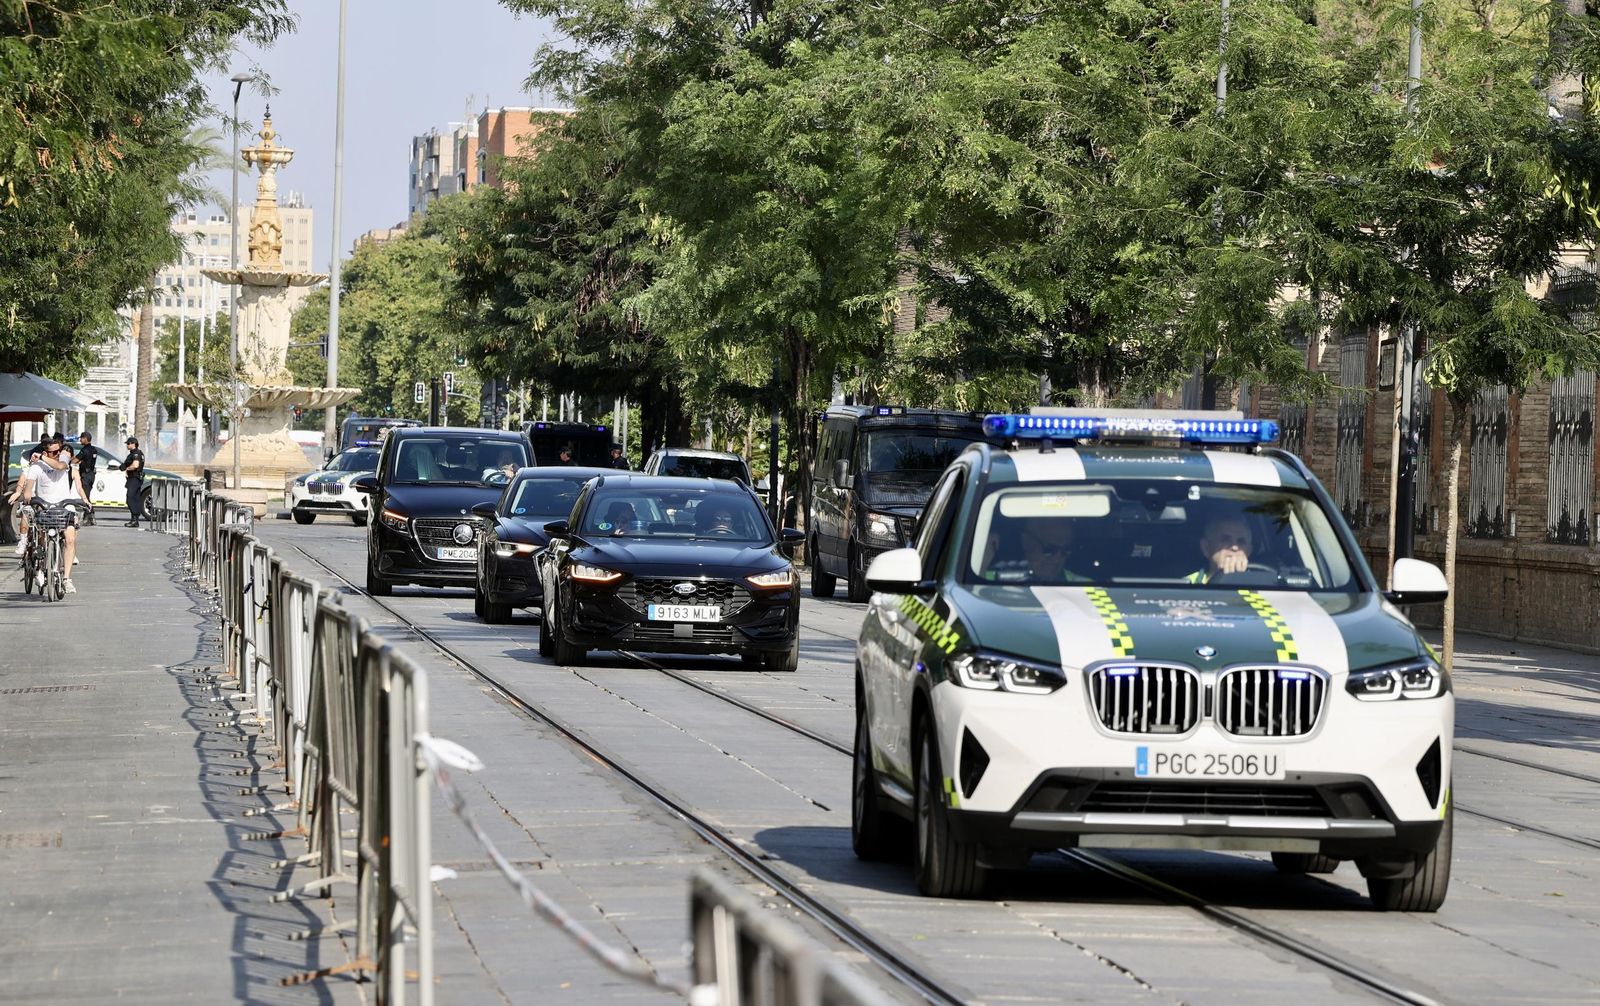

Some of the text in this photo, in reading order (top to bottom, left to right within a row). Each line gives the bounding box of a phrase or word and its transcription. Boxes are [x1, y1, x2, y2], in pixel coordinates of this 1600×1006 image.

[657, 606, 717, 620] 9163 MLM
[1155, 752, 1277, 776] PGC 2506 U
